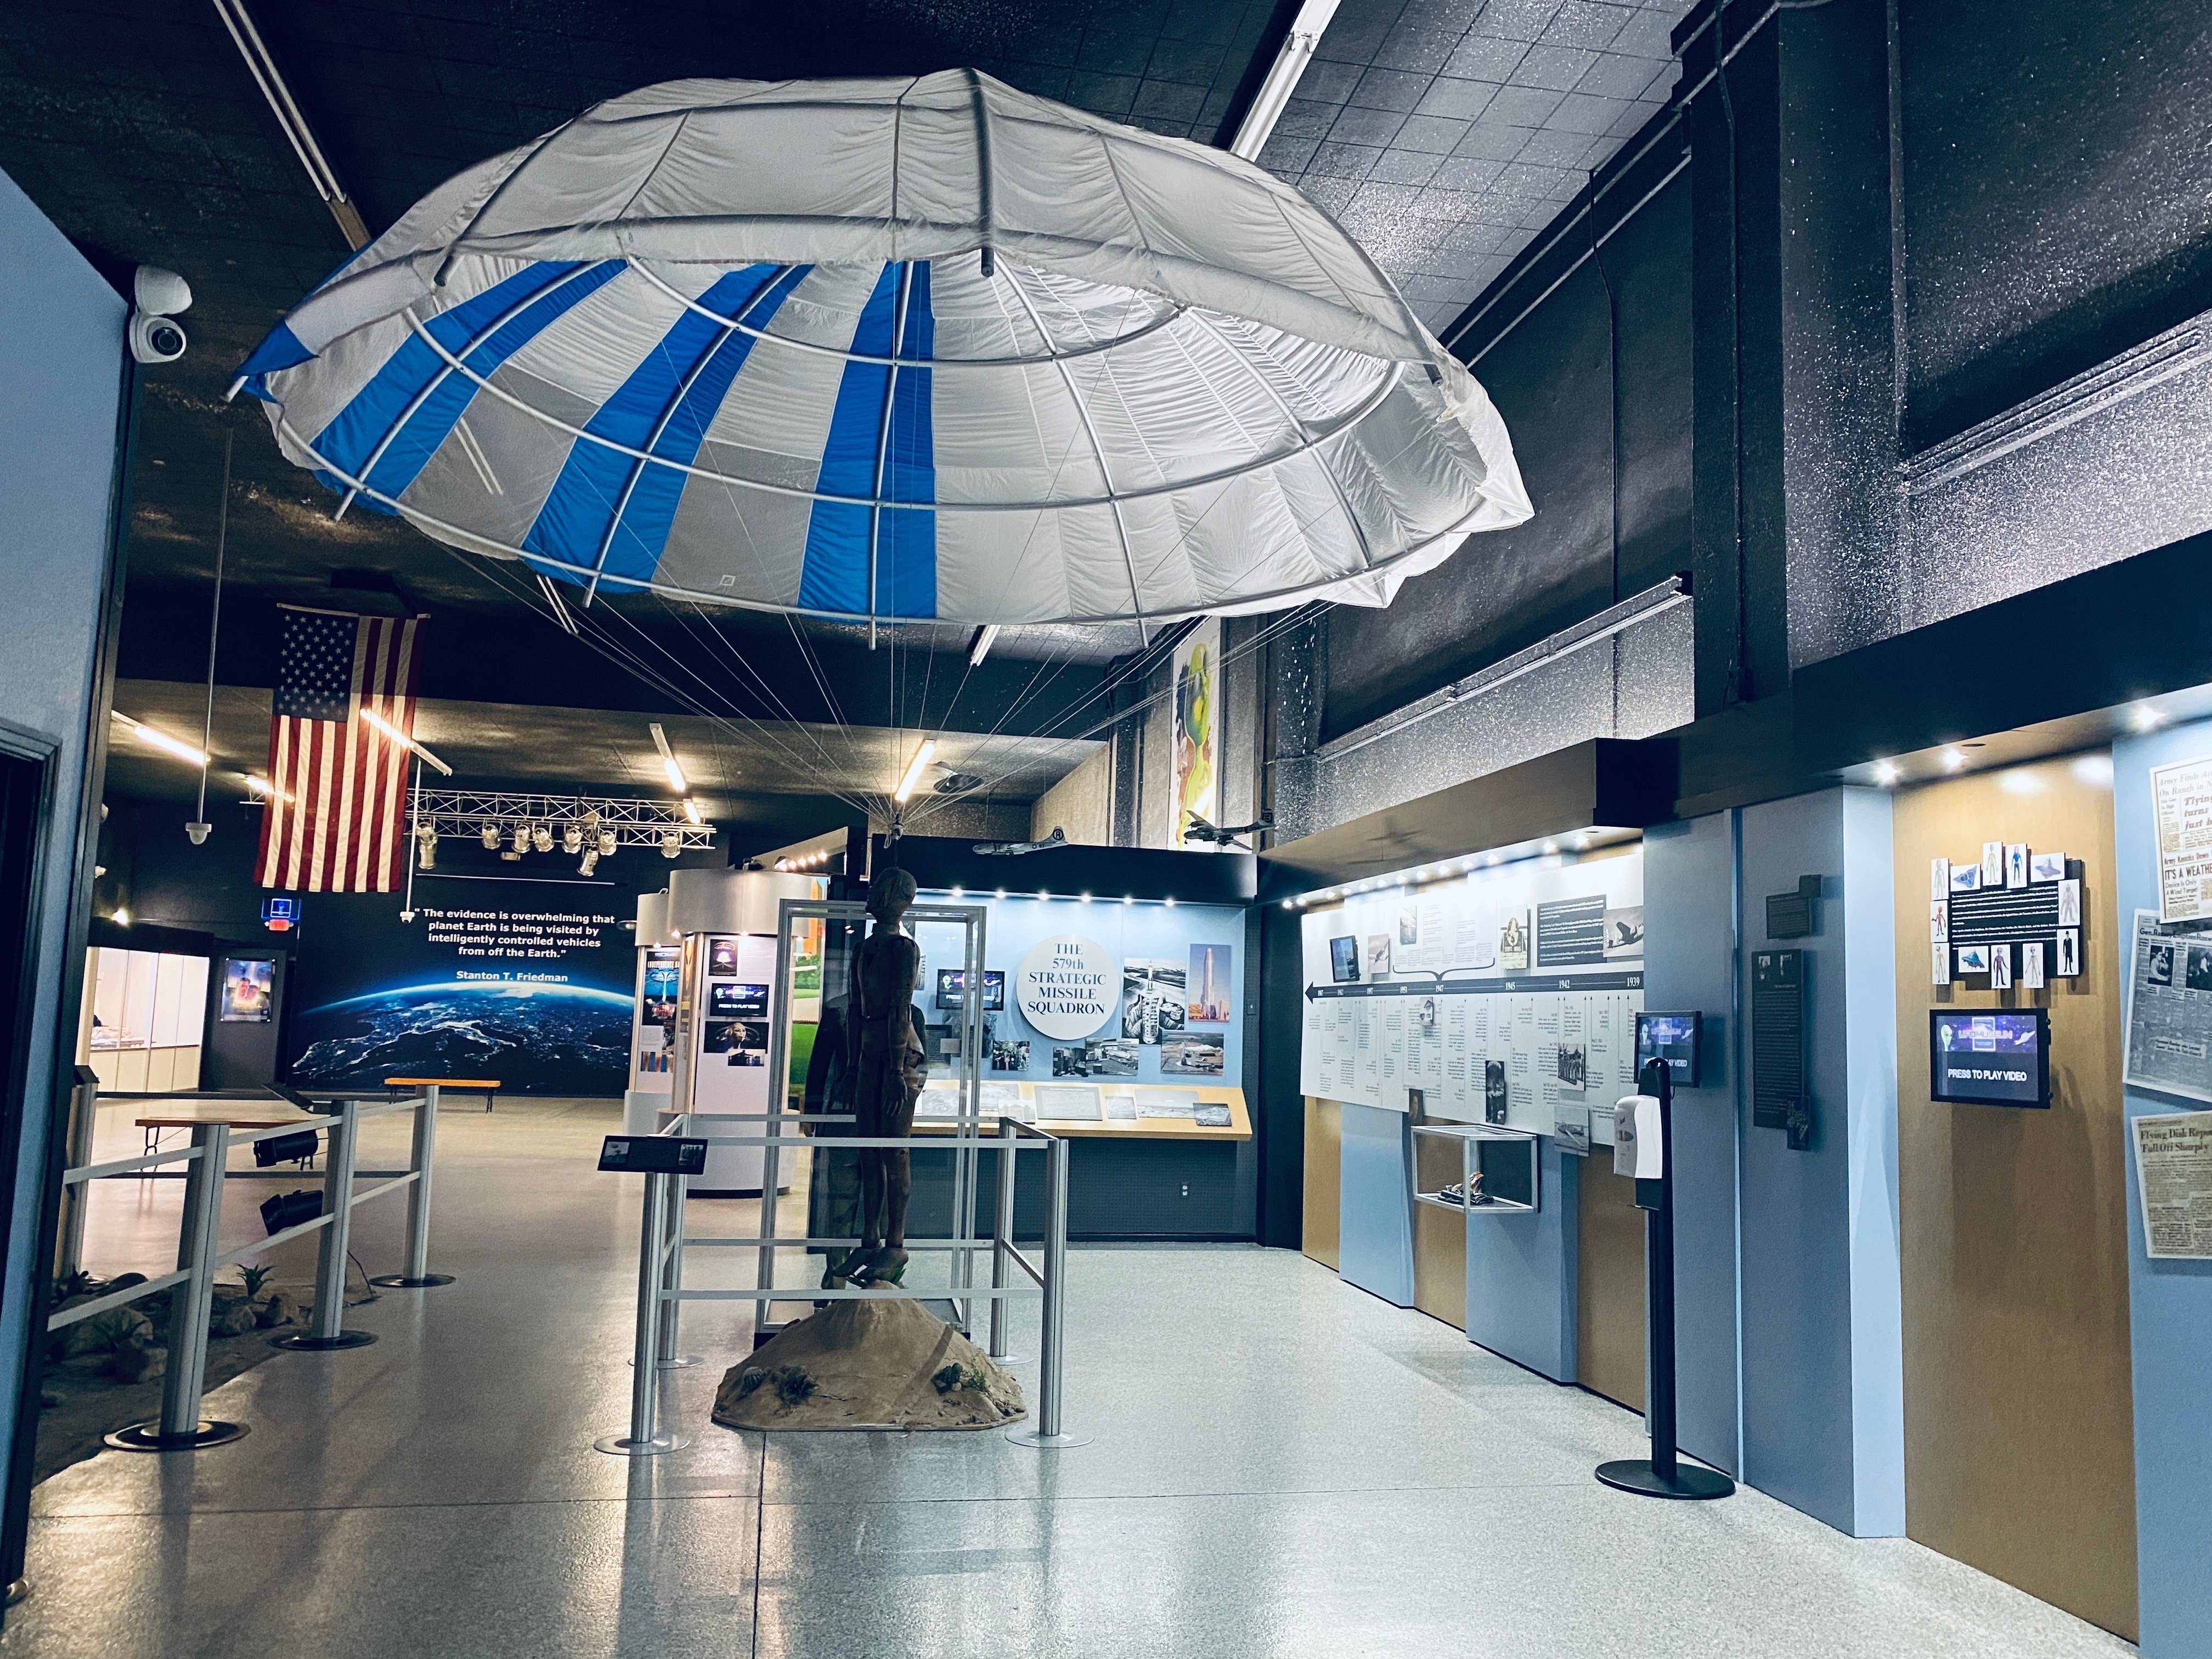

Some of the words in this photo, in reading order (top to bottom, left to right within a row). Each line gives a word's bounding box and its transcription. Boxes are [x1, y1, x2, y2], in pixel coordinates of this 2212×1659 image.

[2181, 772, 2198, 782] Finds
[2159, 789, 2169, 797] On
[2184, 808, 2209, 817] turns
[2185, 820, 2203, 831] just
[2165, 868, 2177, 881] IT'S
[2179, 868, 2183, 878] A
[423, 909, 444, 918] The
[447, 910, 495, 919] evidence
[499, 911, 509, 919] is
[511, 912, 590, 924] overwhelming
[592, 915, 615, 924] that
[428, 922, 464, 932] planet
[467, 923, 496, 932] Earth
[500, 923, 509, 932] is
[512, 924, 543, 935] being
[546, 926, 582, 935] visited
[586, 927, 599, 936] by
[428, 933, 495, 945] intelligently
[498, 936, 554, 946] controlled
[556, 938, 601, 947] vehicles
[458, 946, 484, 956] from
[488, 947, 504, 956] off
[506, 948, 524, 957] the
[528, 949, 567, 958] Earth."
[1054, 943, 1084, 955] THE
[1052, 958, 1084, 969] 579th
[456, 970, 500, 980] Stanton
[503, 972, 514, 980] T.
[517, 973, 568, 982] Friedman
[1029, 972, 1107, 985] STRATEGIC
[1505, 981, 1516, 990] 1945
[1559, 979, 1570, 989] 1942
[1627, 977, 1640, 987] 1939
[1037, 987, 1097, 1000] MISSILE
[1028, 1001, 1105, 1015] SQUADRON
[1948, 1068, 1972, 1079] PRESS
[1972, 1069, 1983, 1080] TO
[1983, 1070, 2003, 1081] PLAY
[2003, 1070, 2028, 1082] VIDEO
[2169, 1128, 2187, 1138] Disk
[2142, 1143, 2159, 1153] Fall
[2175, 1141, 2209, 1154] Sharply
